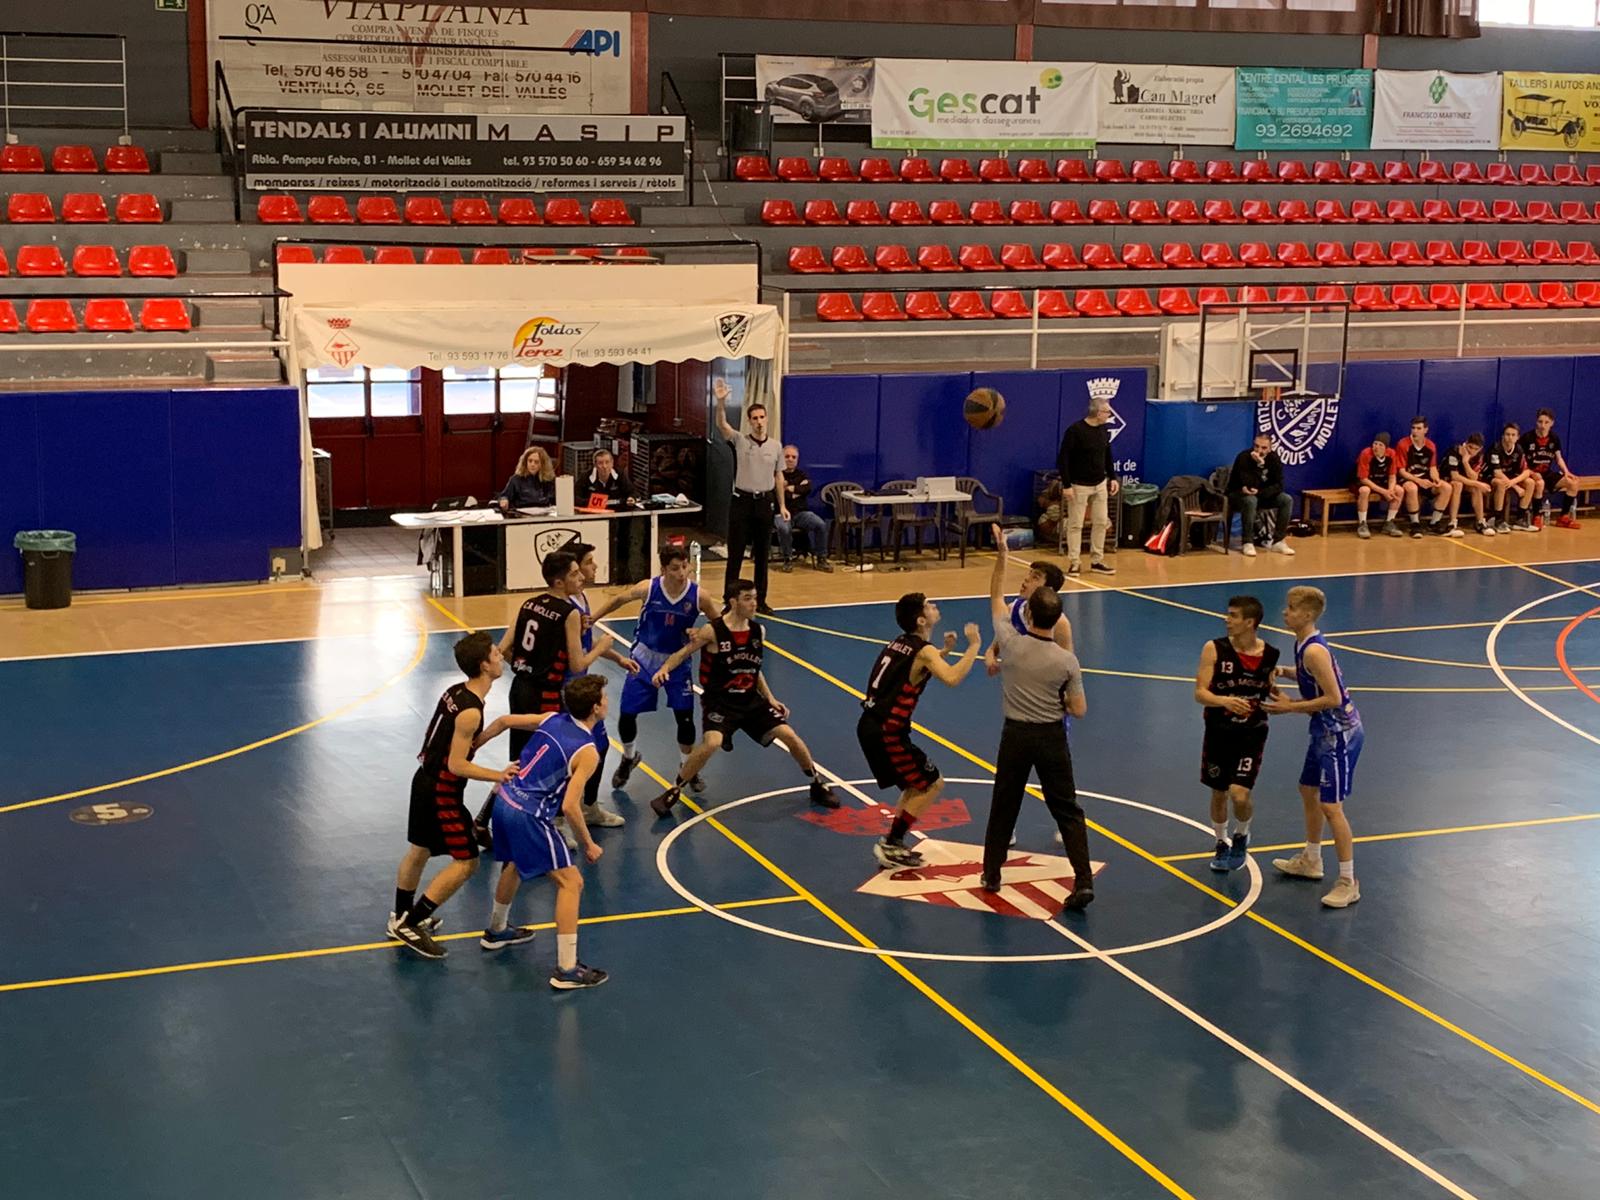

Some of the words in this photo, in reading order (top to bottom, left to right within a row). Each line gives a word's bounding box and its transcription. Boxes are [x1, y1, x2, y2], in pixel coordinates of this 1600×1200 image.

[352, 24, 394, 34] COMPRA
[441, 28, 455, 36] DE
[457, 28, 499, 38] FINQUES
[568, 29, 620, 58] API
[322, 53, 378, 64] ASSESSORIA
[436, 57, 469, 67] FISCAL
[472, 58, 528, 68] COMPTABLE
[325, 65, 345, 78] 46
[1239, 73, 1272, 83] CENTRE
[1275, 73, 1306, 84] DENTAL
[1308, 74, 1324, 84] LES
[1509, 78, 1548, 89] TALLERS
[1554, 80, 1585, 90] AUTOS
[417, 84, 475, 98] MOLLET
[1140, 88, 1166, 102] Can
[1171, 90, 1217, 107] Magret
[908, 86, 1041, 124] Gescat
[937, 116, 981, 125] mediadors
[1403, 111, 1438, 119] FRANCISCO
[251, 120, 351, 139] TENDALS
[359, 122, 367, 139] I
[374, 123, 471, 140] ALUMINI
[488, 124, 674, 142] MASIP
[1255, 124, 1277, 137] 93
[1280, 124, 1353, 138] 2694692
[252, 154, 279, 165] Rbla.
[282, 154, 325, 167] Pompeu
[364, 155, 376, 165] 81
[387, 156, 420, 166] Mollet
[423, 156, 439, 166] del
[522, 157, 535, 166] 93
[538, 157, 557, 167] 570
[560, 157, 572, 167] 50
[575, 157, 588, 167] 60
[598, 157, 616, 167] 659
[619, 157, 631, 167] 54
[634, 157, 647, 167] 62
[649, 157, 662, 167] 96
[254, 178, 315, 188] mampares
[326, 178, 361, 188] reixes
[542, 178, 590, 189] reformes
[600, 178, 637, 189] serveis
[448, 351, 459, 361] 93
[462, 351, 480, 361] 593
[483, 351, 494, 361] 17
[497, 351, 508, 361] 76
[594, 348, 605, 358] 93
[607, 348, 625, 357] 593
[627, 347, 639, 357] 64
[641, 347, 652, 356] 41
[1257, 399, 1272, 433] CLUB
[1313, 399, 1340, 450] MOLLET
[1123, 459, 1137, 472] de
[521, 619, 539, 652] 6
[719, 640, 732, 653] 33
[871, 655, 892, 689] 7
[1221, 661, 1234, 674] 13
[1237, 757, 1253, 772] 13
